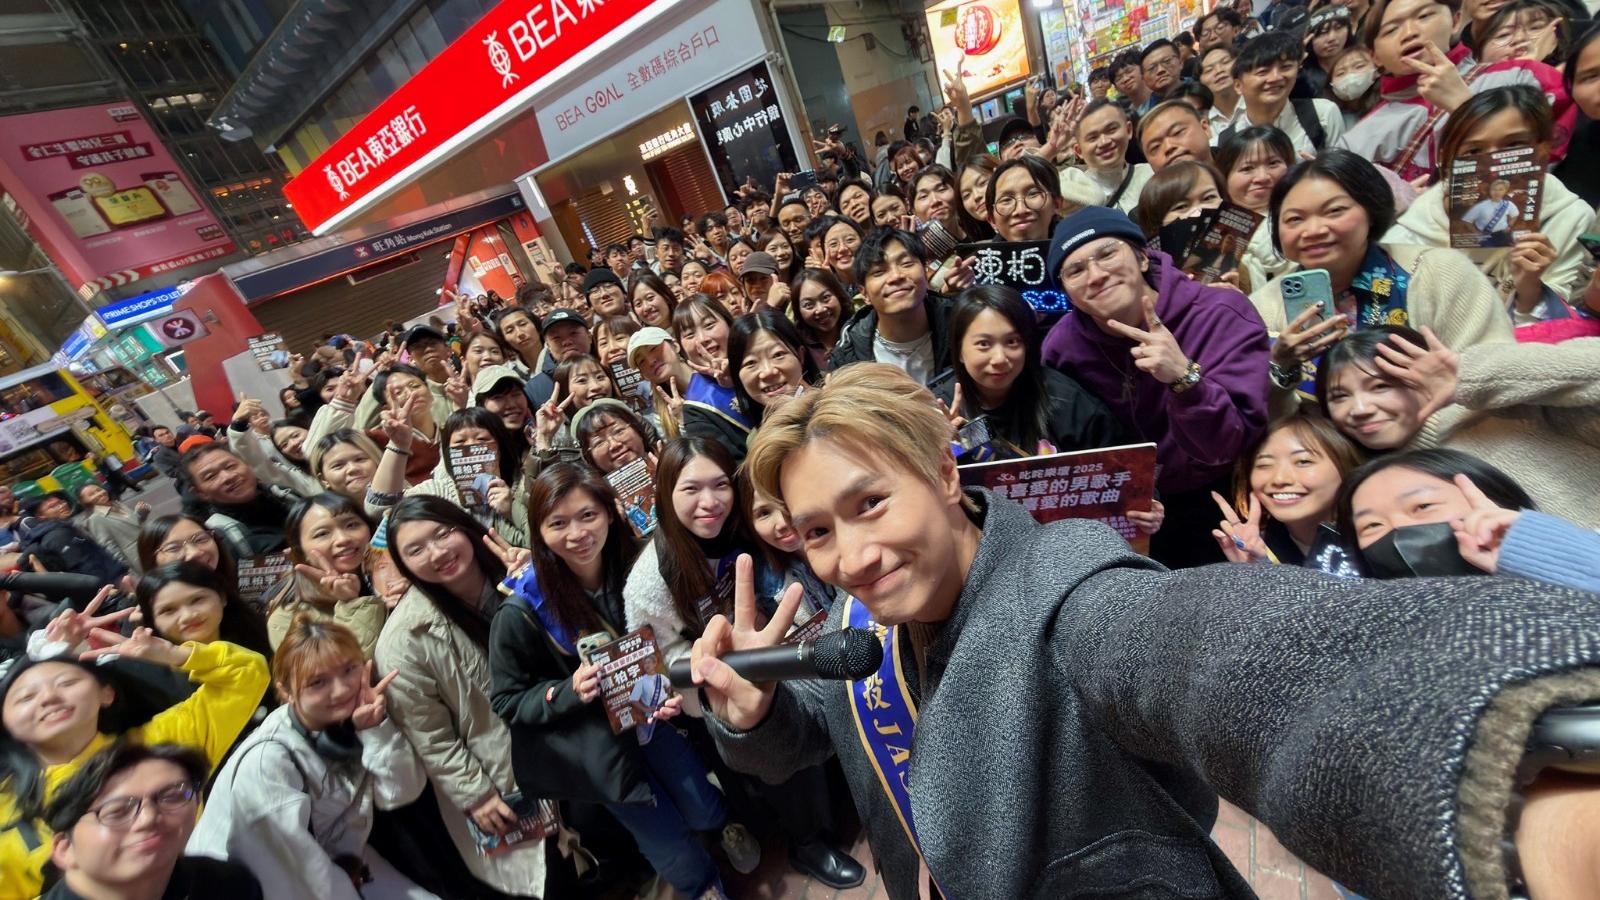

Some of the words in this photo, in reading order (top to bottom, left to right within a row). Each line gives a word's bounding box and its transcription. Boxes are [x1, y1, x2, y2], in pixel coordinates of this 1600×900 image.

[507, 0, 578, 62] BEA
[555, 106, 585, 132] BEA
[585, 82, 624, 115] GOAL
[626, 25, 720, 91] 全數碼綜合戶口
[336, 146, 378, 187] BEA
[365, 105, 428, 165] 東亞銀行
[372, 234, 407, 252] 旺角站
[406, 232, 425, 242] Mong
[432, 223, 452, 234] Station
[156, 294, 169, 303] TO
[1073, 462, 1104, 474] 2025
[1012, 488, 1121, 512] 喜愛的歌曲
